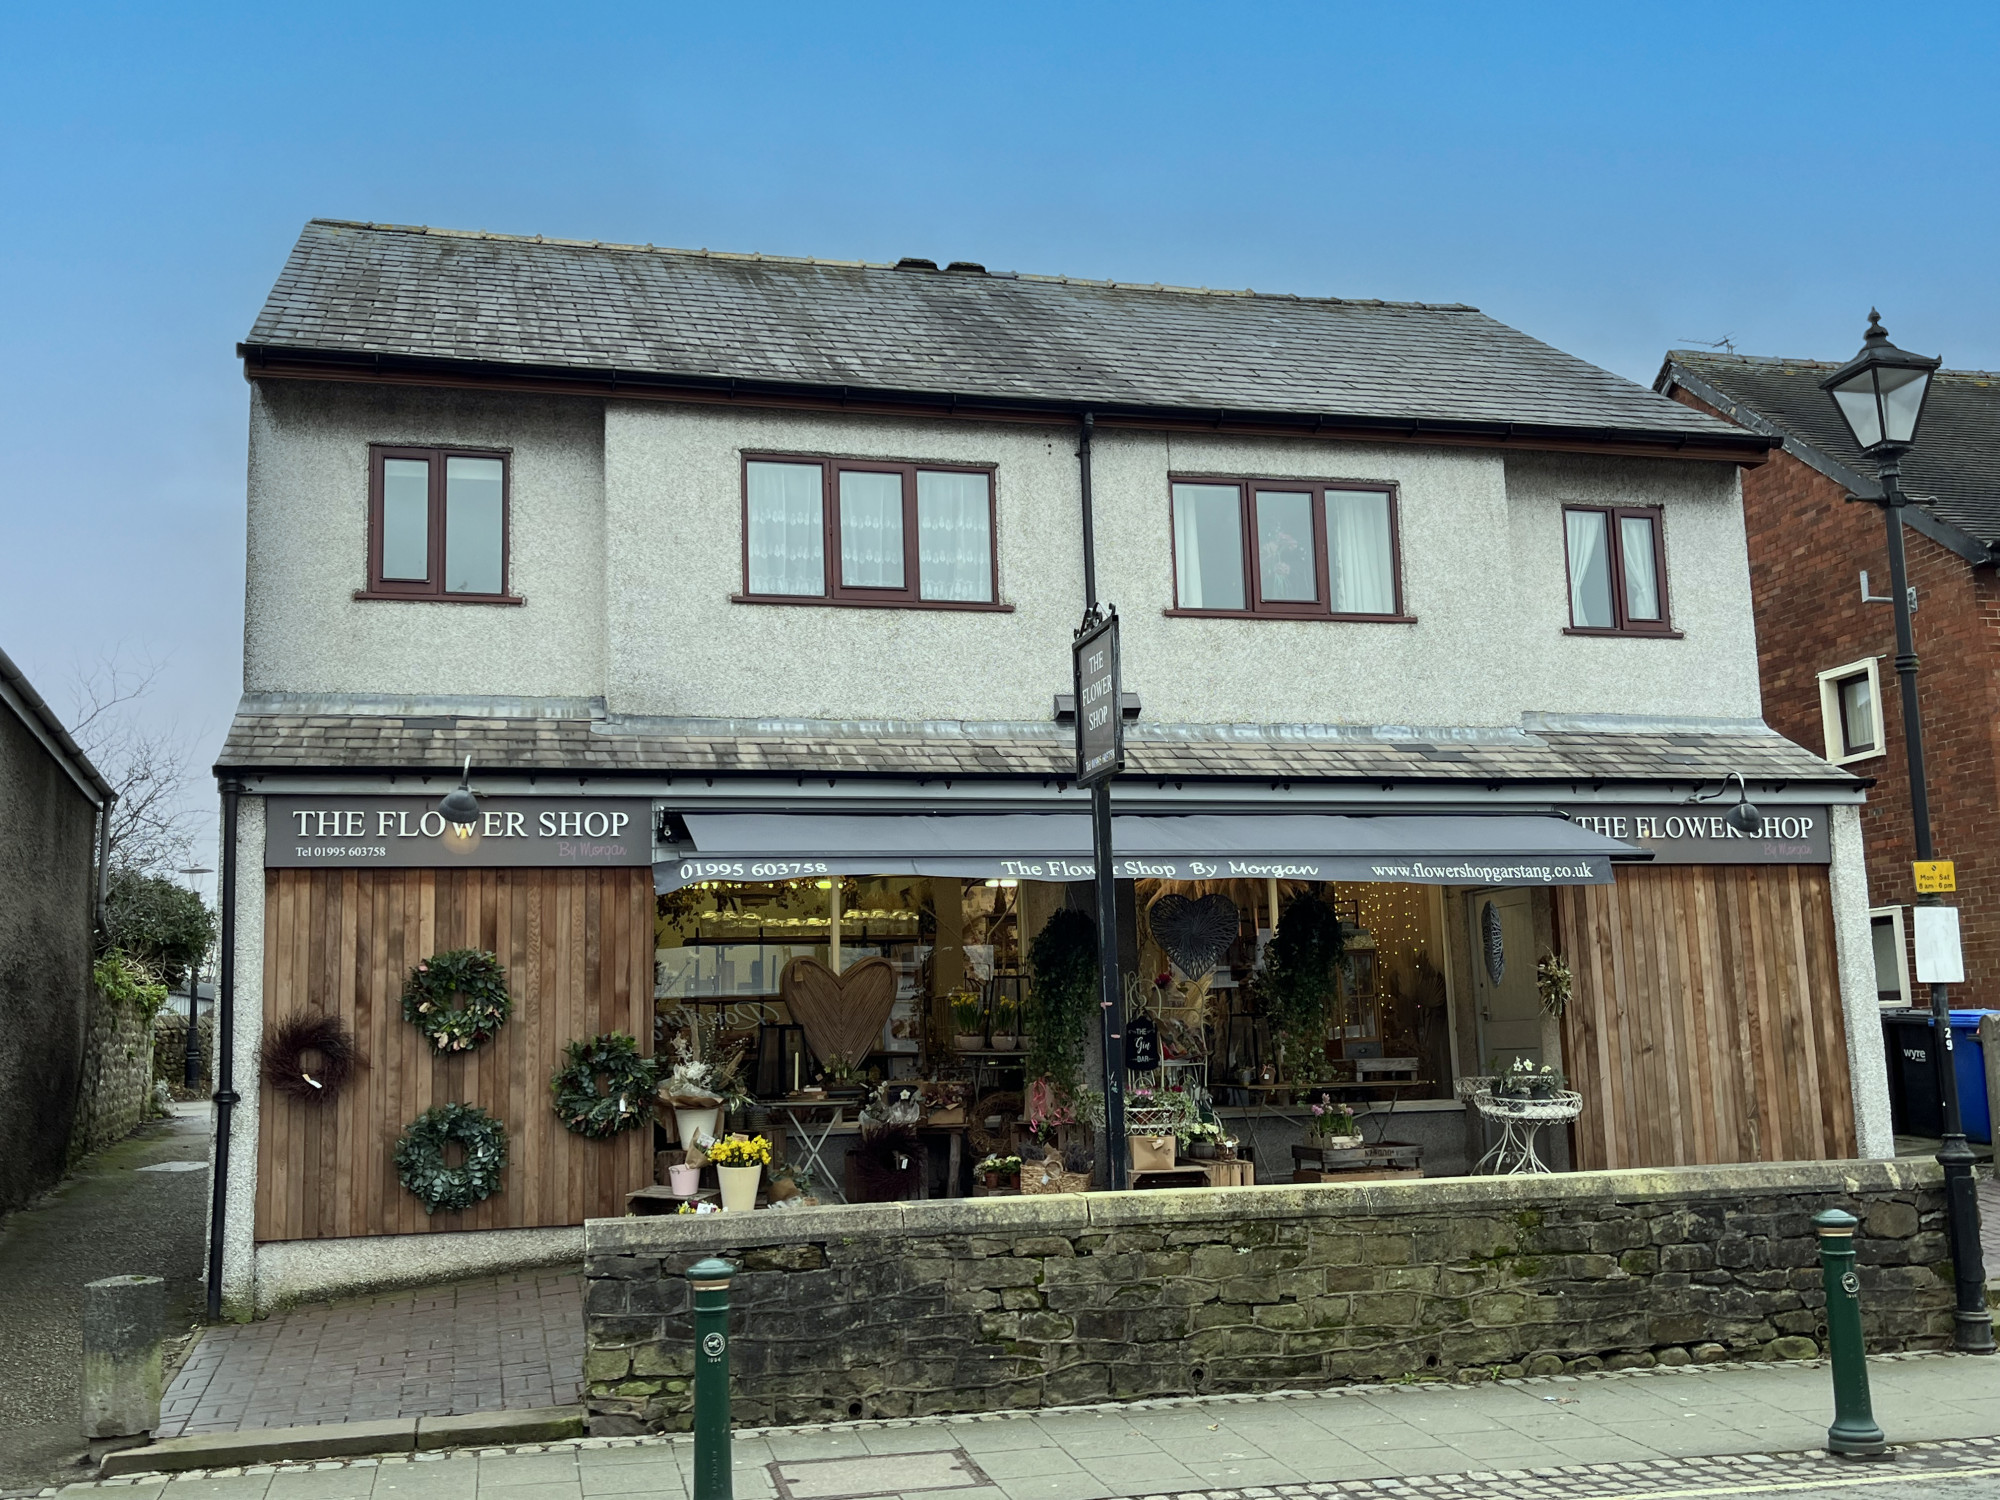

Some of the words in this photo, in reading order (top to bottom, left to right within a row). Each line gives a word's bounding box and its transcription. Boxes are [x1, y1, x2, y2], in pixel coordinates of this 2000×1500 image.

[1088, 650, 1104, 675] THE
[1082, 674, 1113, 708] FLOWER
[1088, 705, 1108, 731] SHOP
[292, 810, 366, 838] THE
[538, 811, 630, 838] SHOP
[1575, 816, 1629, 838] THE
[295, 846, 312, 857] Tel
[314, 846, 346, 857] 01995
[348, 846, 386, 857] 603758
[557, 841, 577, 860] By
[680, 862, 744, 879] 01995
[751, 862, 828, 877] 603758
[1000, 860, 1043, 876] The
[1046, 861, 1119, 877] Flowr
[1124, 861, 1176, 878] Shop
[1189, 862, 1217, 878] By
[1228, 861, 1319, 878] Morgan
[1370, 862, 1594, 882] www.flowershopgarstang.co.uk
[1939, 873, 1951, 881] Sat
[1135, 1036, 1150, 1054] Gin
[1903, 1048, 1926, 1060] wyre
